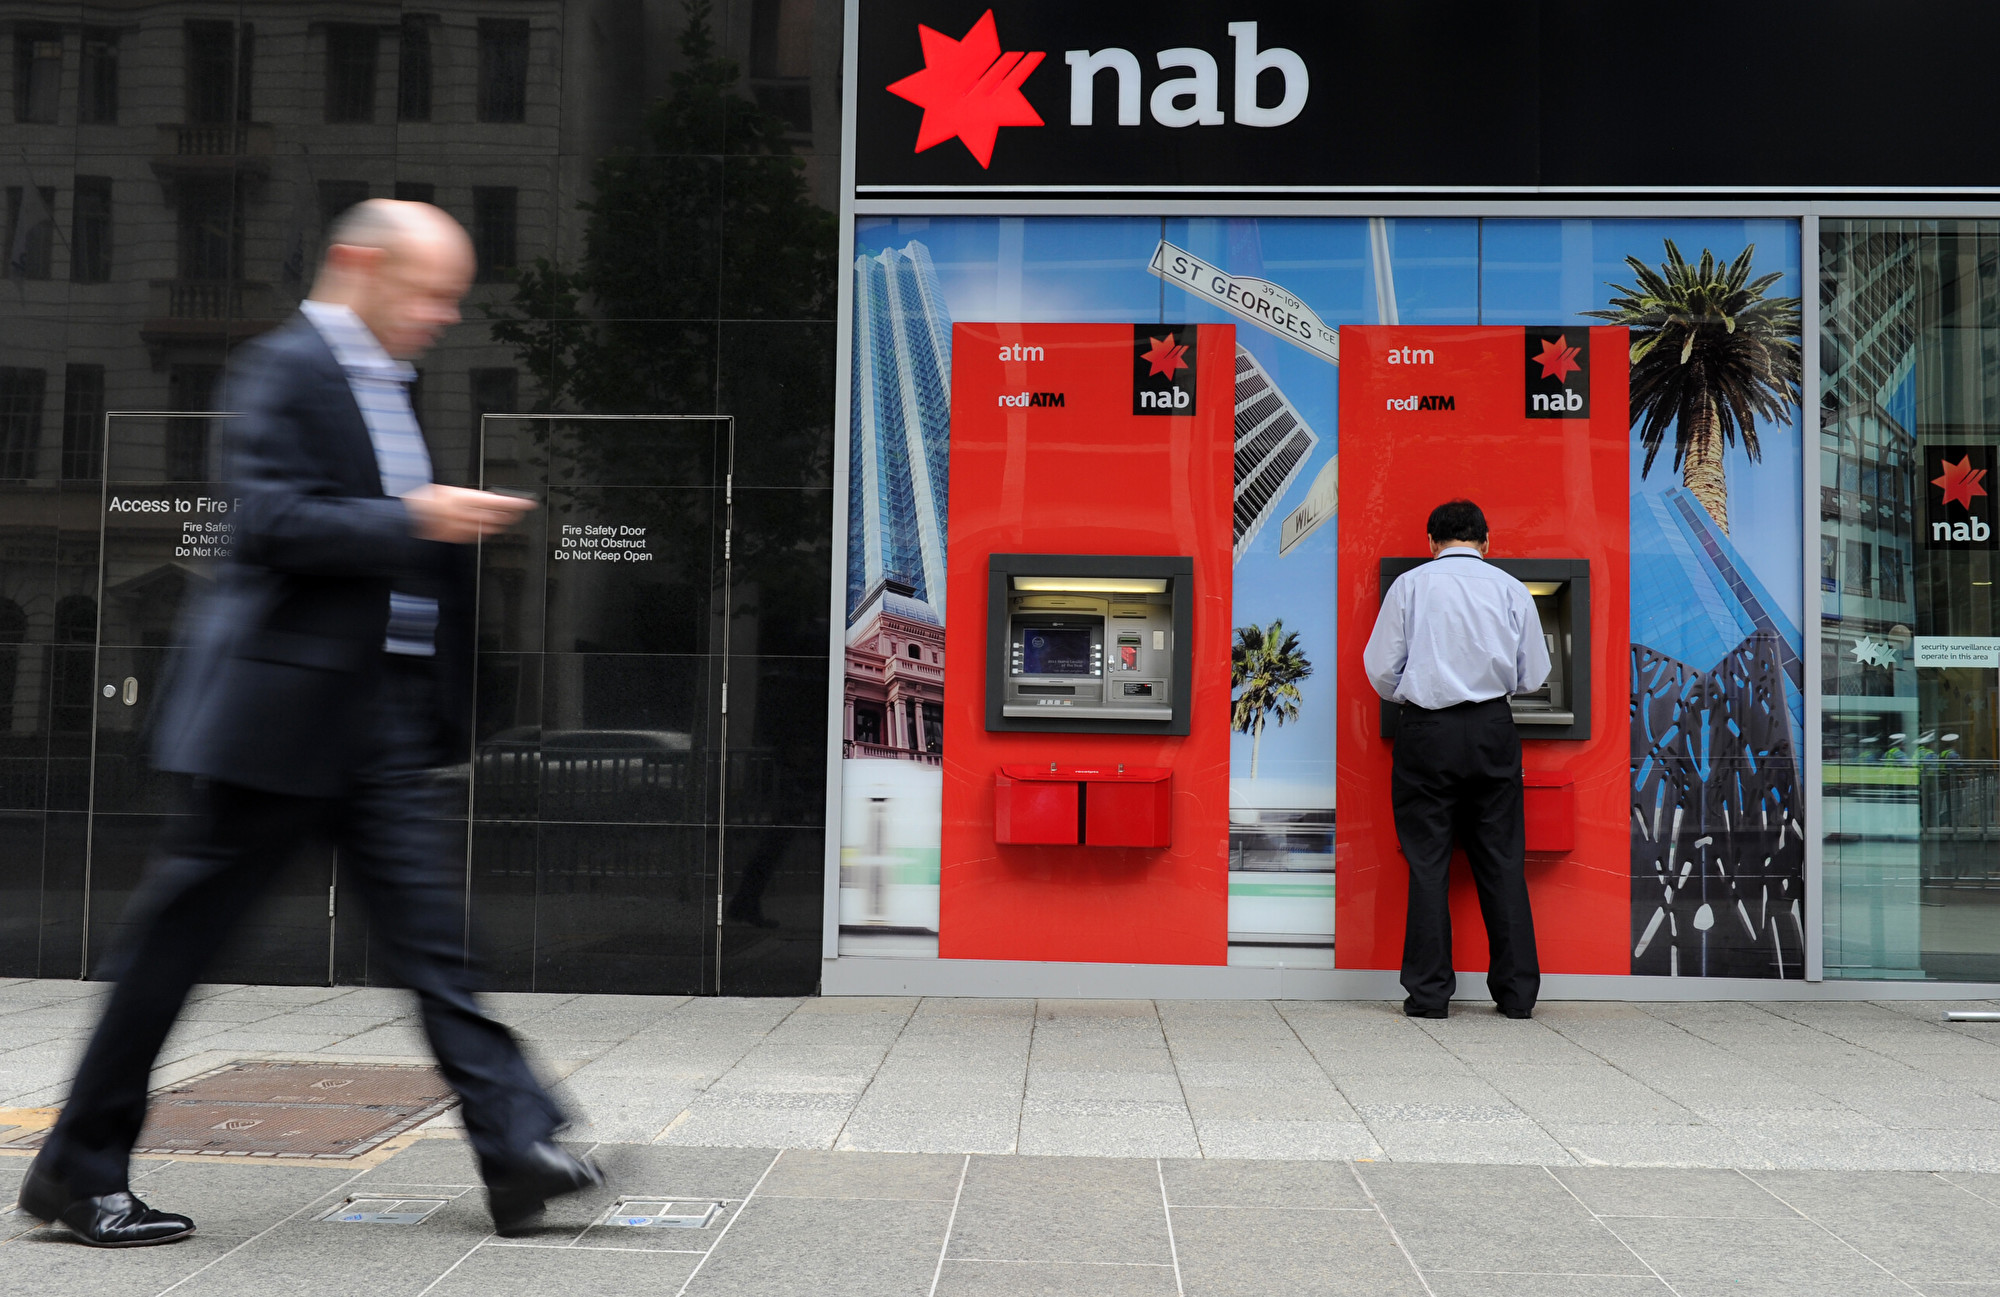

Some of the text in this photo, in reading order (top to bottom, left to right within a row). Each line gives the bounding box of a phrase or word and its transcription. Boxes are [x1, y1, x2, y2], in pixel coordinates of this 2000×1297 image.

[1065, 21, 1309, 128] nab
[1171, 256, 1336, 346] ST GEORGES TCE
[998, 343, 1044, 362] atm
[1387, 346, 1434, 365] atm
[998, 392, 1065, 408] rediATM
[1140, 386, 1190, 409] nab
[1386, 395, 1455, 411] rediATM
[1532, 388, 1583, 411] nab
[109, 496, 170, 513] Access
[174, 498, 191, 513] to
[196, 497, 228, 513] Fire
[183, 522, 237, 534] Fire Safety
[562, 525, 646, 538] Fire Safety Door
[1931, 516, 1991, 542] nab
[182, 534, 198, 545] Do
[200, 534, 218, 545] Not
[561, 537, 646, 549] Do Not Obstruct
[175, 546, 191, 557] Do
[193, 547, 211, 557] Not
[554, 550, 653, 563] Do Not Keep Open
[1921, 643, 1949, 652] security
[1950, 643, 1992, 651] surveillance
[1921, 653, 1949, 661] operate
